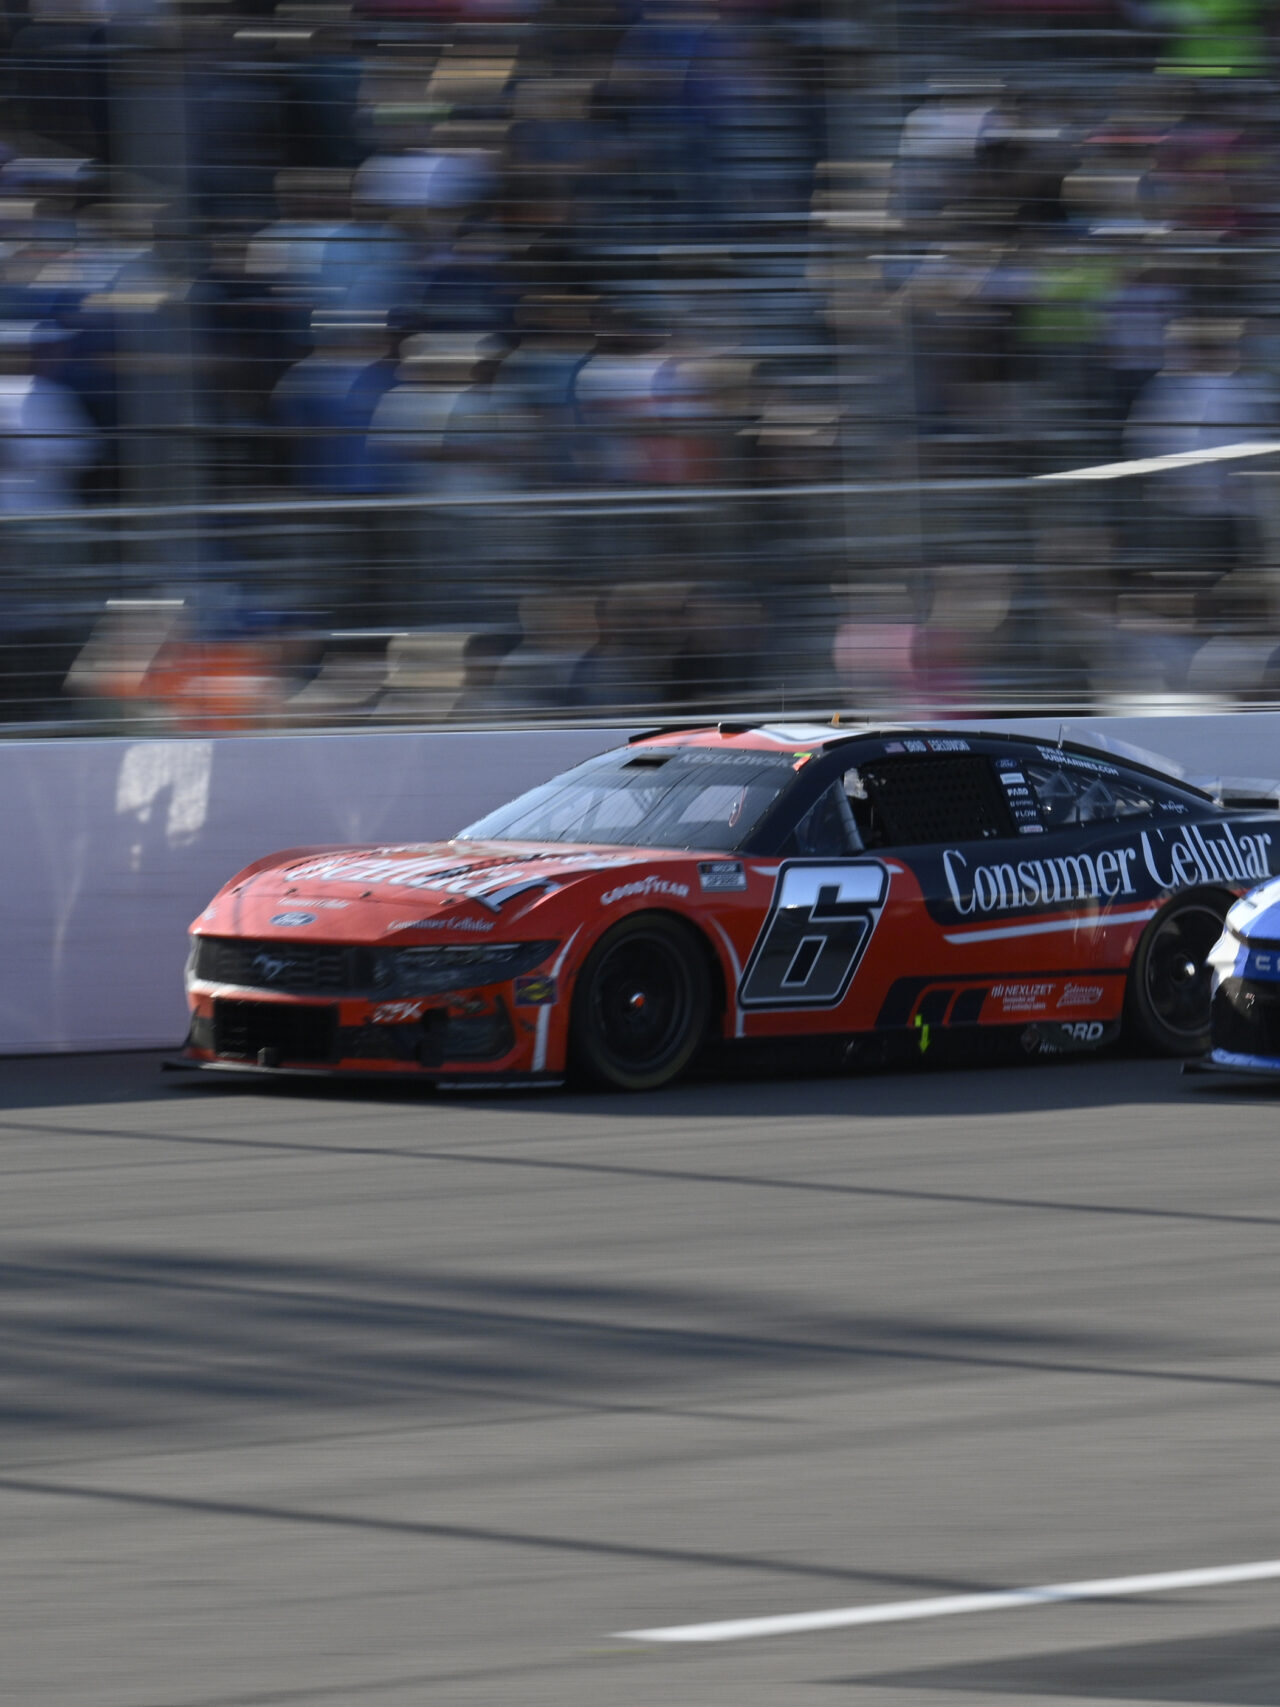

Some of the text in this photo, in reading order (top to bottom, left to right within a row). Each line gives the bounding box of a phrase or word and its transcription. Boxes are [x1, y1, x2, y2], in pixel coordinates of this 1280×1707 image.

[600, 875, 690, 906] GOODYEAR
[942, 822, 1273, 915] Consumer Cellular
[740, 860, 889, 1008] 6
[1004, 983, 1056, 998] NEXLIZET
